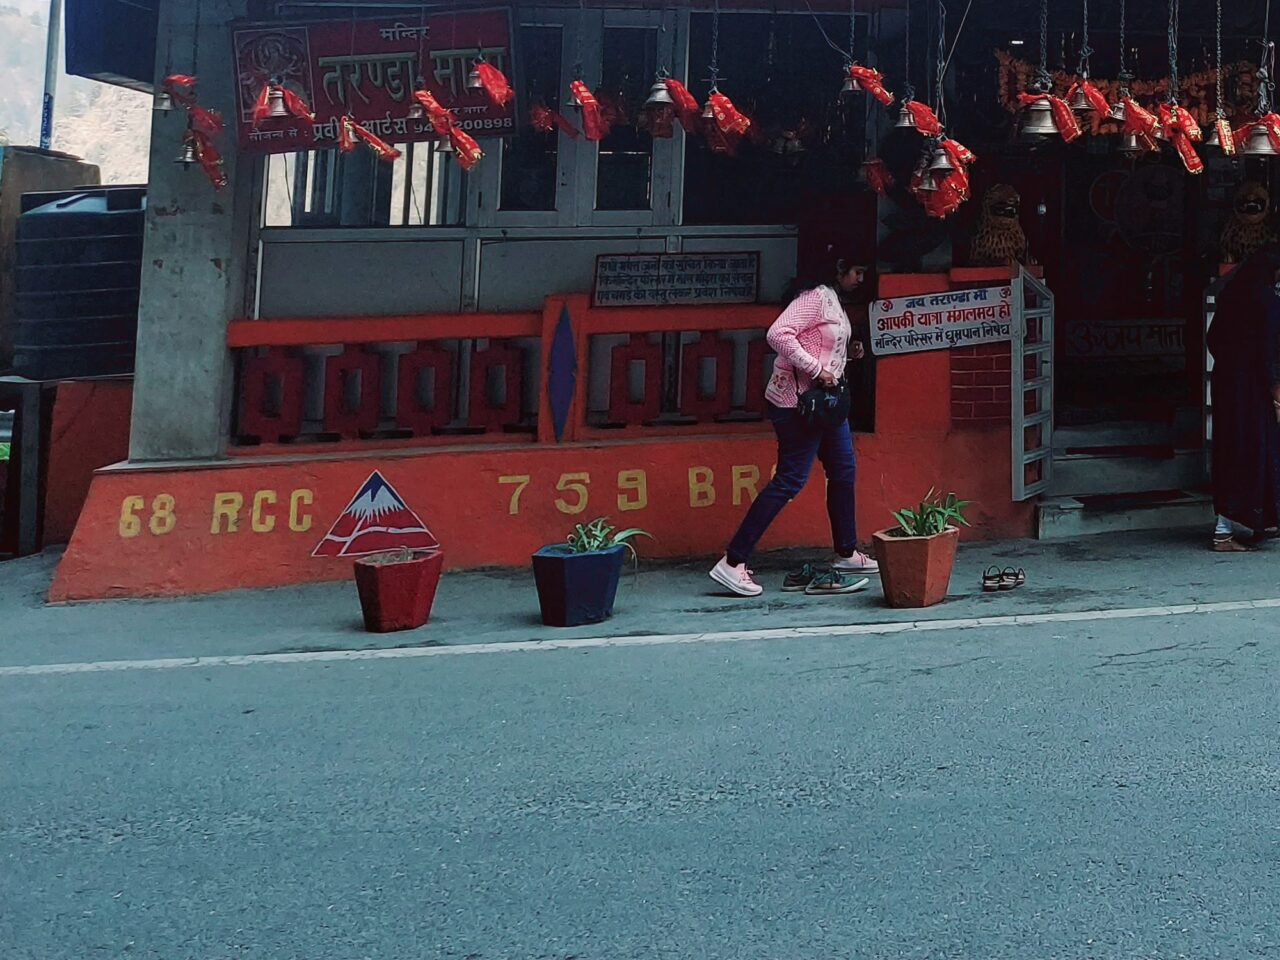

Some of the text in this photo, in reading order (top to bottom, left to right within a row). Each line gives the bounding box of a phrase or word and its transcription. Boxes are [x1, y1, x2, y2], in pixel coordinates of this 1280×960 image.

[380, 23, 431, 41] मन्दिर
[312, 116, 343, 142] प्रवी
[415, 117, 512, 134] 94200898
[877, 310, 915, 331] आपकी
[917, 311, 944, 326] यात्रा
[946, 304, 996, 323] मंगलमय
[118, 488, 315, 538] 68 RCC
